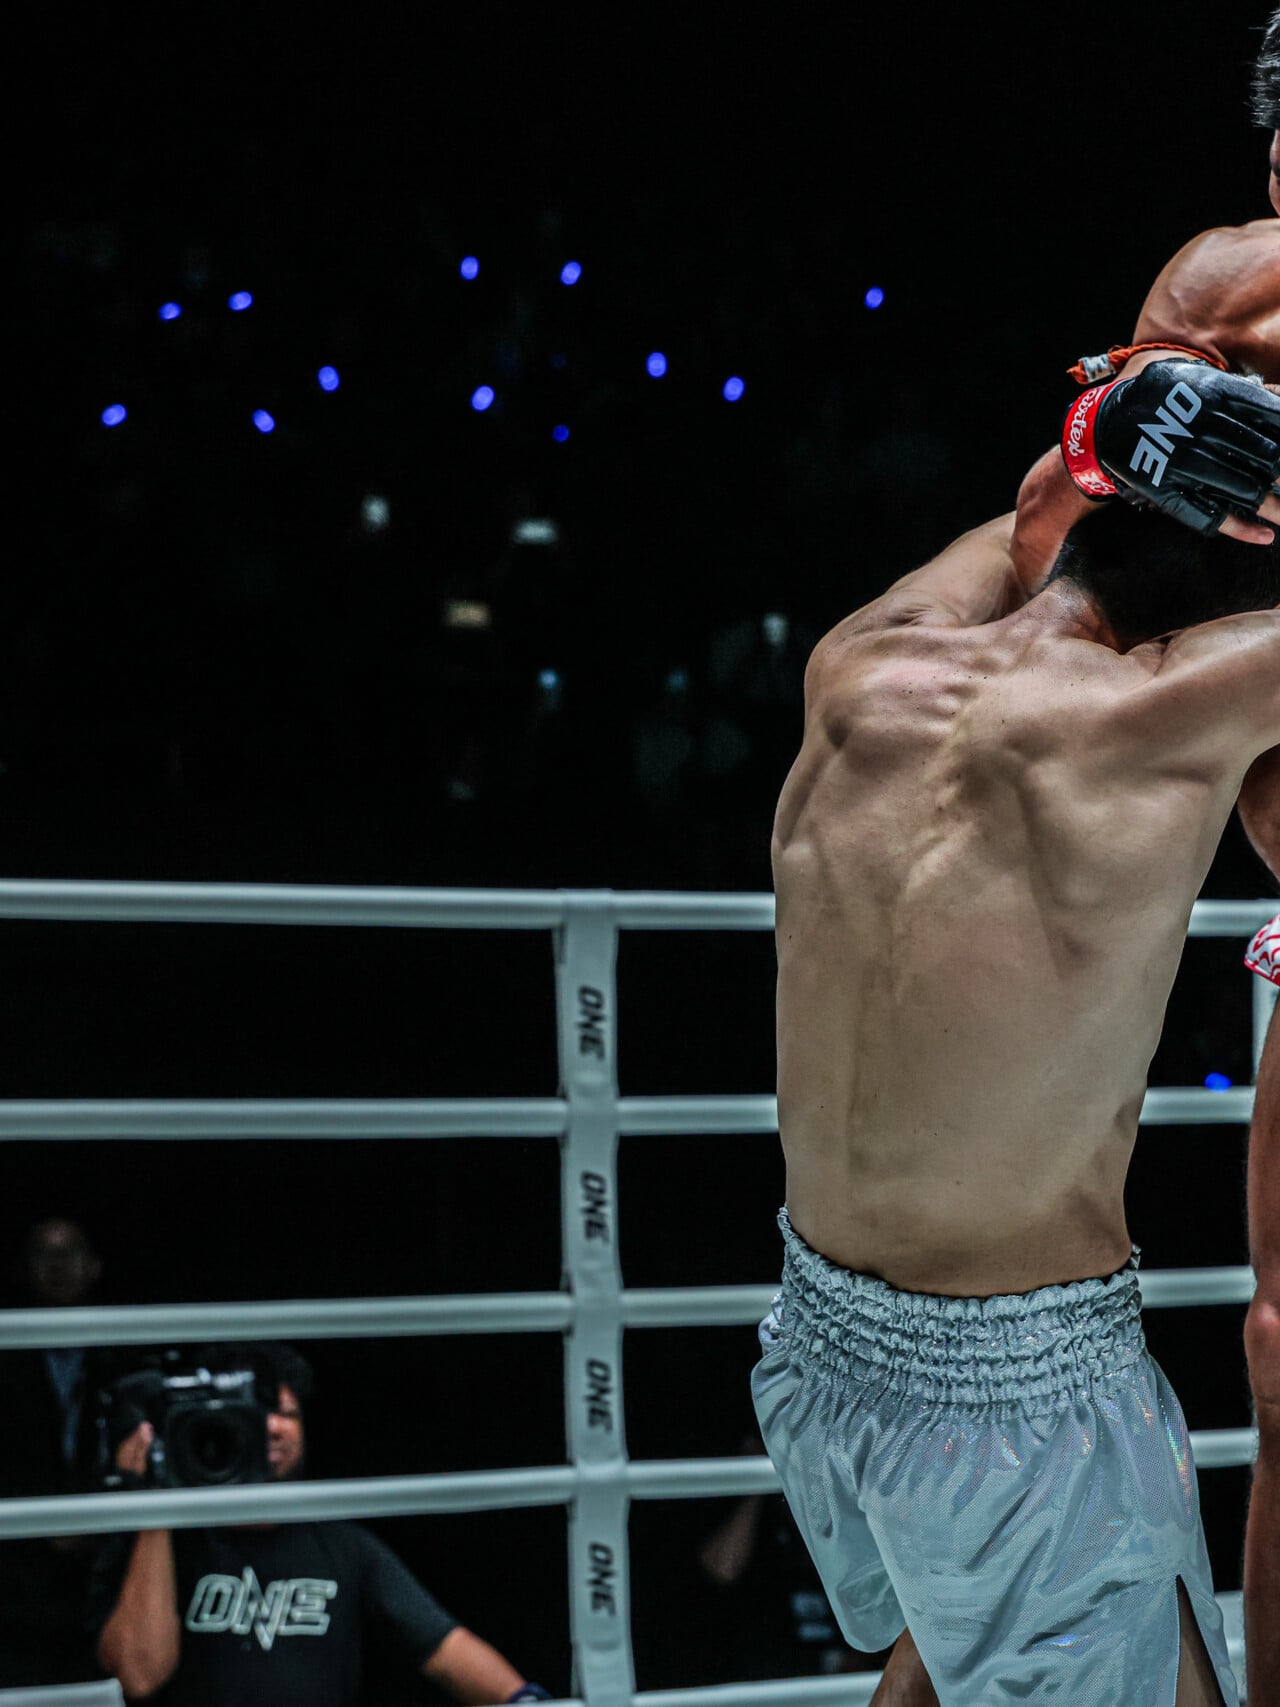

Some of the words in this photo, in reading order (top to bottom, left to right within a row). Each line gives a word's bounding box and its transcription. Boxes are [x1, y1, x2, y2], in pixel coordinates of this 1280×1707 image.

[1129, 382, 1202, 488] ONE
[575, 984, 606, 1061] ONE
[579, 1170, 610, 1244] ONE
[583, 1358, 613, 1436] ONE
[185, 1566, 338, 1650] ONE
[586, 1541, 617, 1618] ONE
